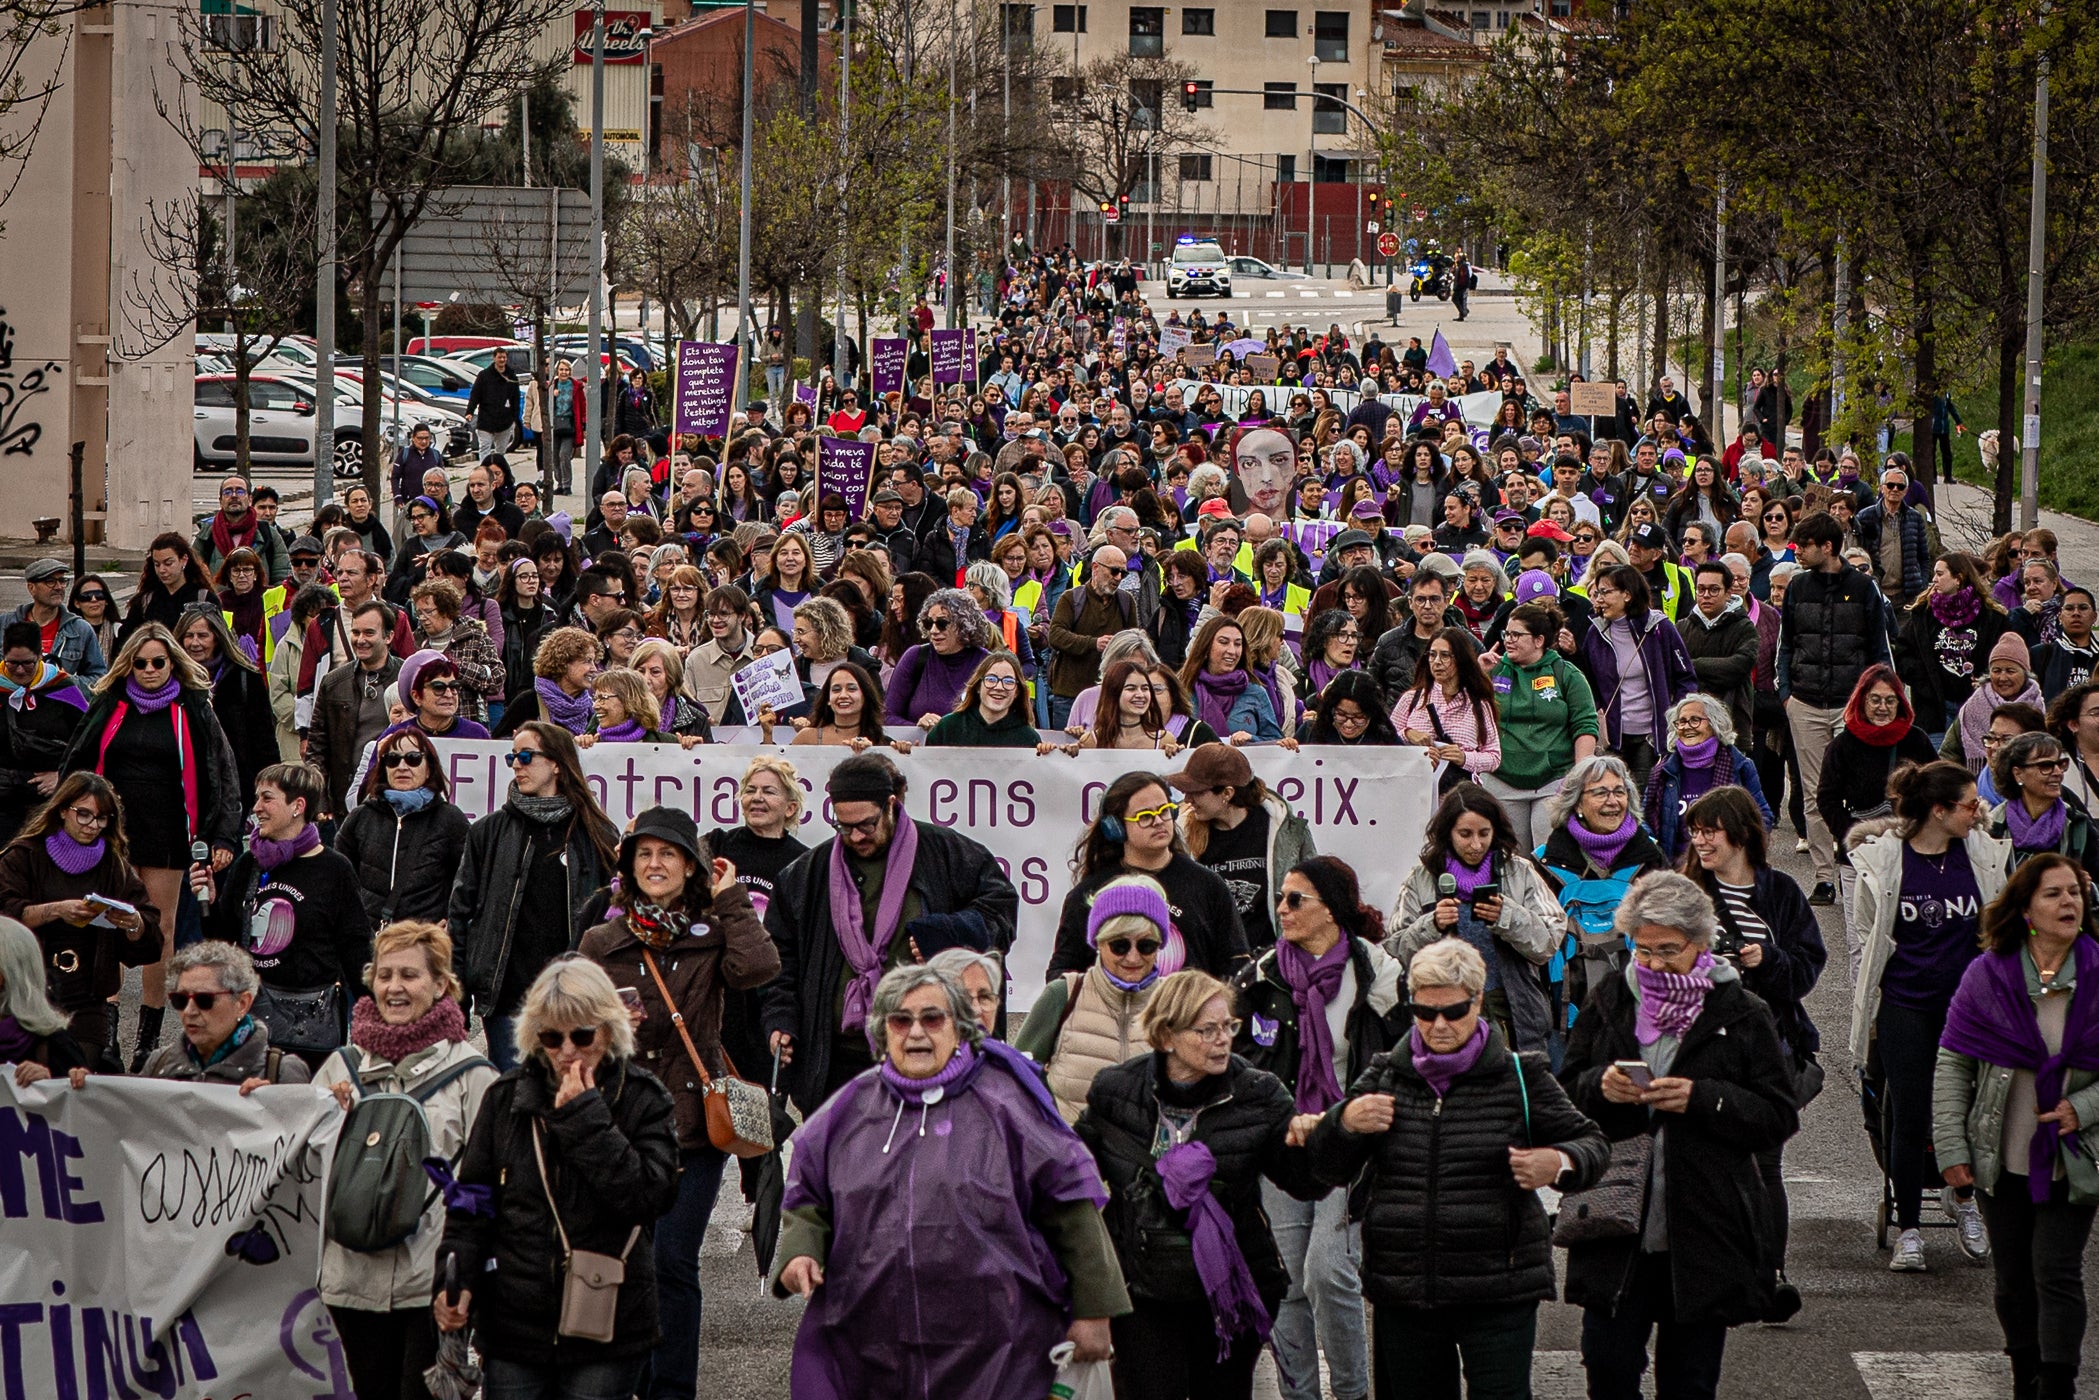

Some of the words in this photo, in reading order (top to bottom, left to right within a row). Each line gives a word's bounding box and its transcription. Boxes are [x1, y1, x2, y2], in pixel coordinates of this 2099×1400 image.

[611, 21, 632, 35] Dr.
[685, 347, 700, 356] Ets
[682, 357, 706, 366] dona
[709, 356, 725, 364] tan
[683, 366, 724, 379] completa
[688, 379, 705, 390] que
[685, 387, 725, 397] mereixes
[683, 400, 698, 410] que
[701, 395, 727, 407] ningú
[691, 418, 719, 428] mitges
[835, 448, 866, 457] meva
[823, 458, 846, 469] vida
[850, 457, 863, 469] té
[821, 470, 849, 482] valor,
[853, 470, 865, 480] el
[845, 484, 865, 493] cos
[845, 493, 857, 505] té
[450, 752, 497, 820] El
[929, 779, 1036, 828] ens
[278, 883, 304, 902] UNIDES
